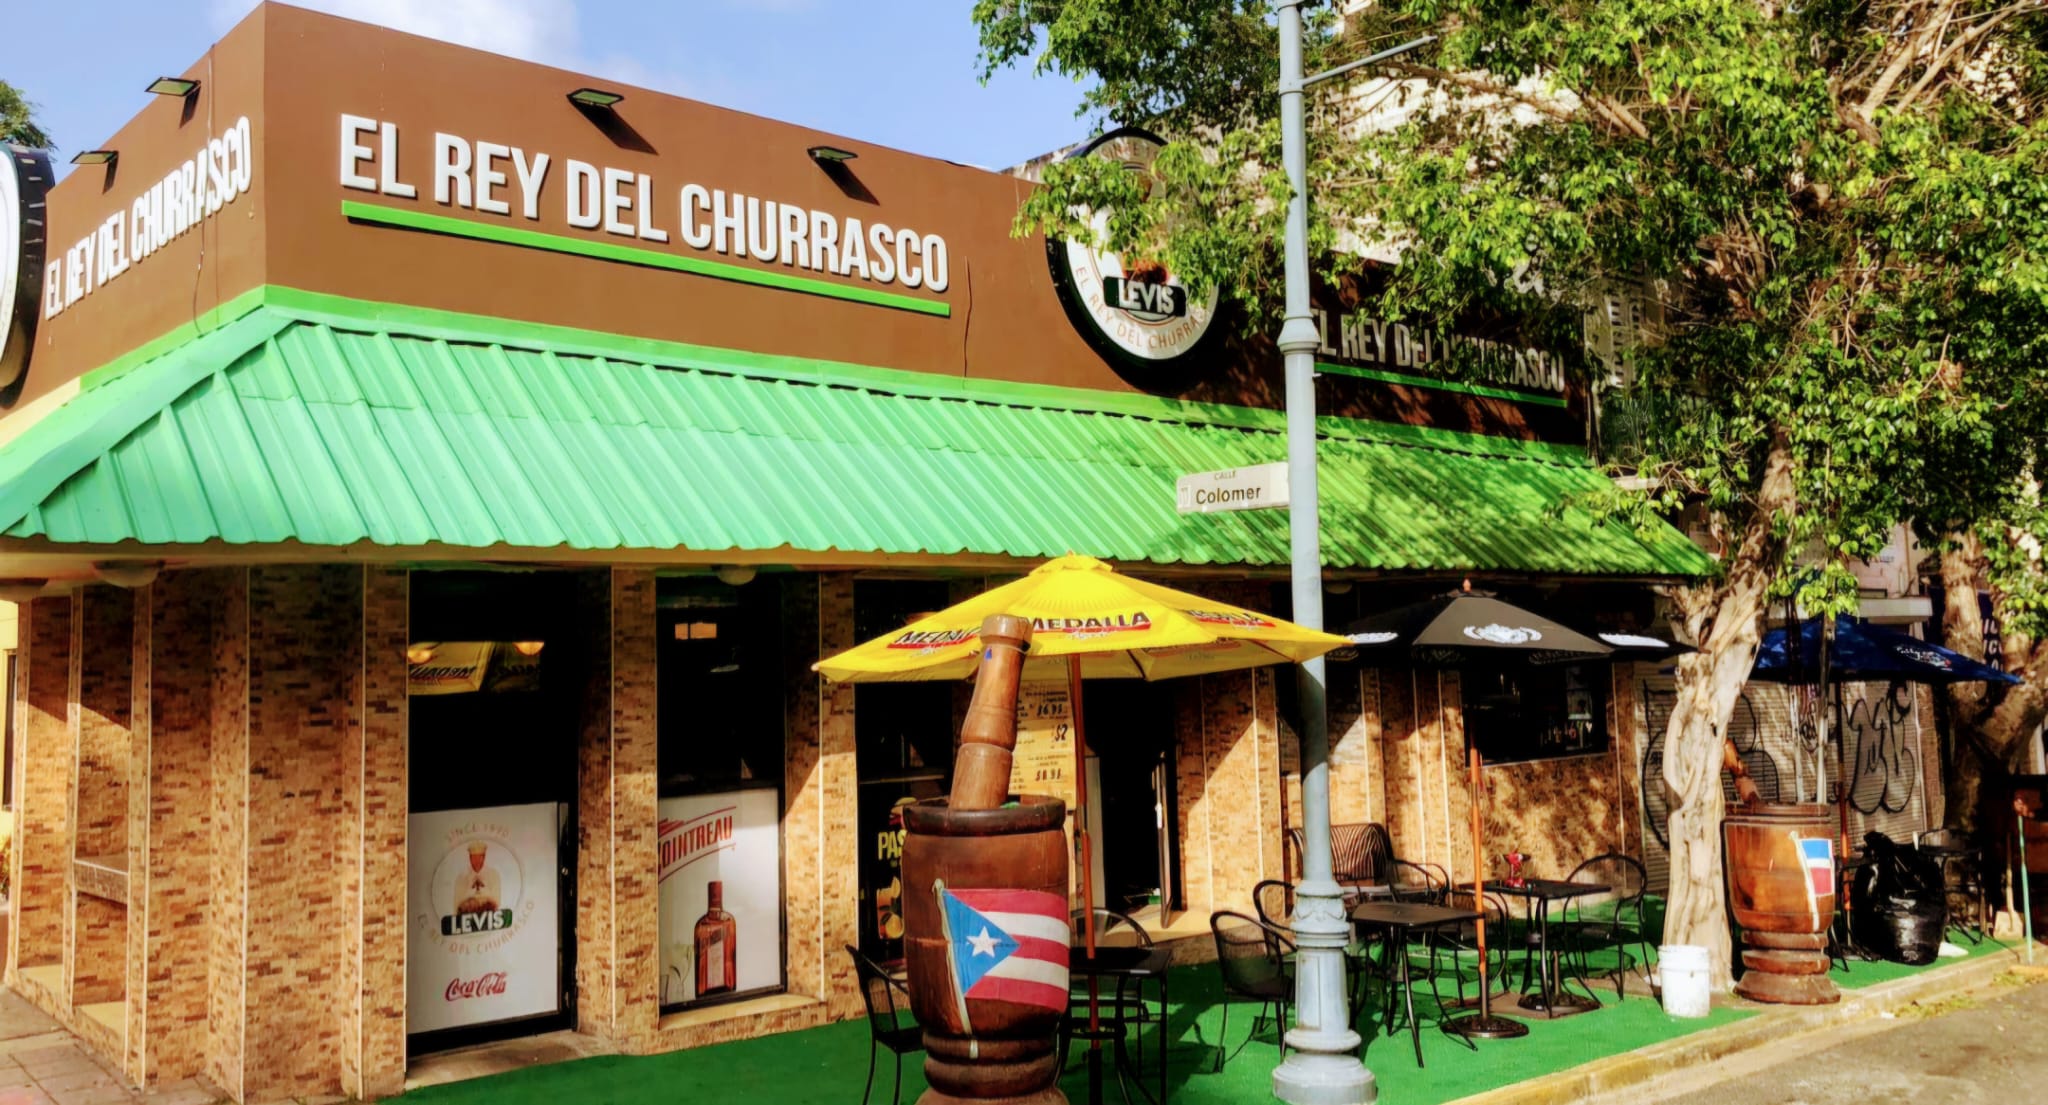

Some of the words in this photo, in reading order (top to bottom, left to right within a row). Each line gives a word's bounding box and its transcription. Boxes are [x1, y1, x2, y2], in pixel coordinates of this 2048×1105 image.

[45, 258, 63, 320] EL
[65, 231, 97, 308] REY
[97, 210, 129, 287] DEL
[131, 116, 251, 263] CHURRASCO
[340, 113, 416, 198] EL
[435, 132, 550, 219] REY
[567, 158, 668, 242] DEL
[680, 183, 949, 293] CHURRASCO
[1075, 267, 1090, 290] EL
[1090, 294, 1113, 324] REY
[1117, 323, 1143, 348] DEL
[1117, 278, 1175, 315] LEVIS
[1340, 314, 1388, 364] REY
[1195, 486, 1262, 505] Colomer
[450, 909, 505, 935] LEVIS
